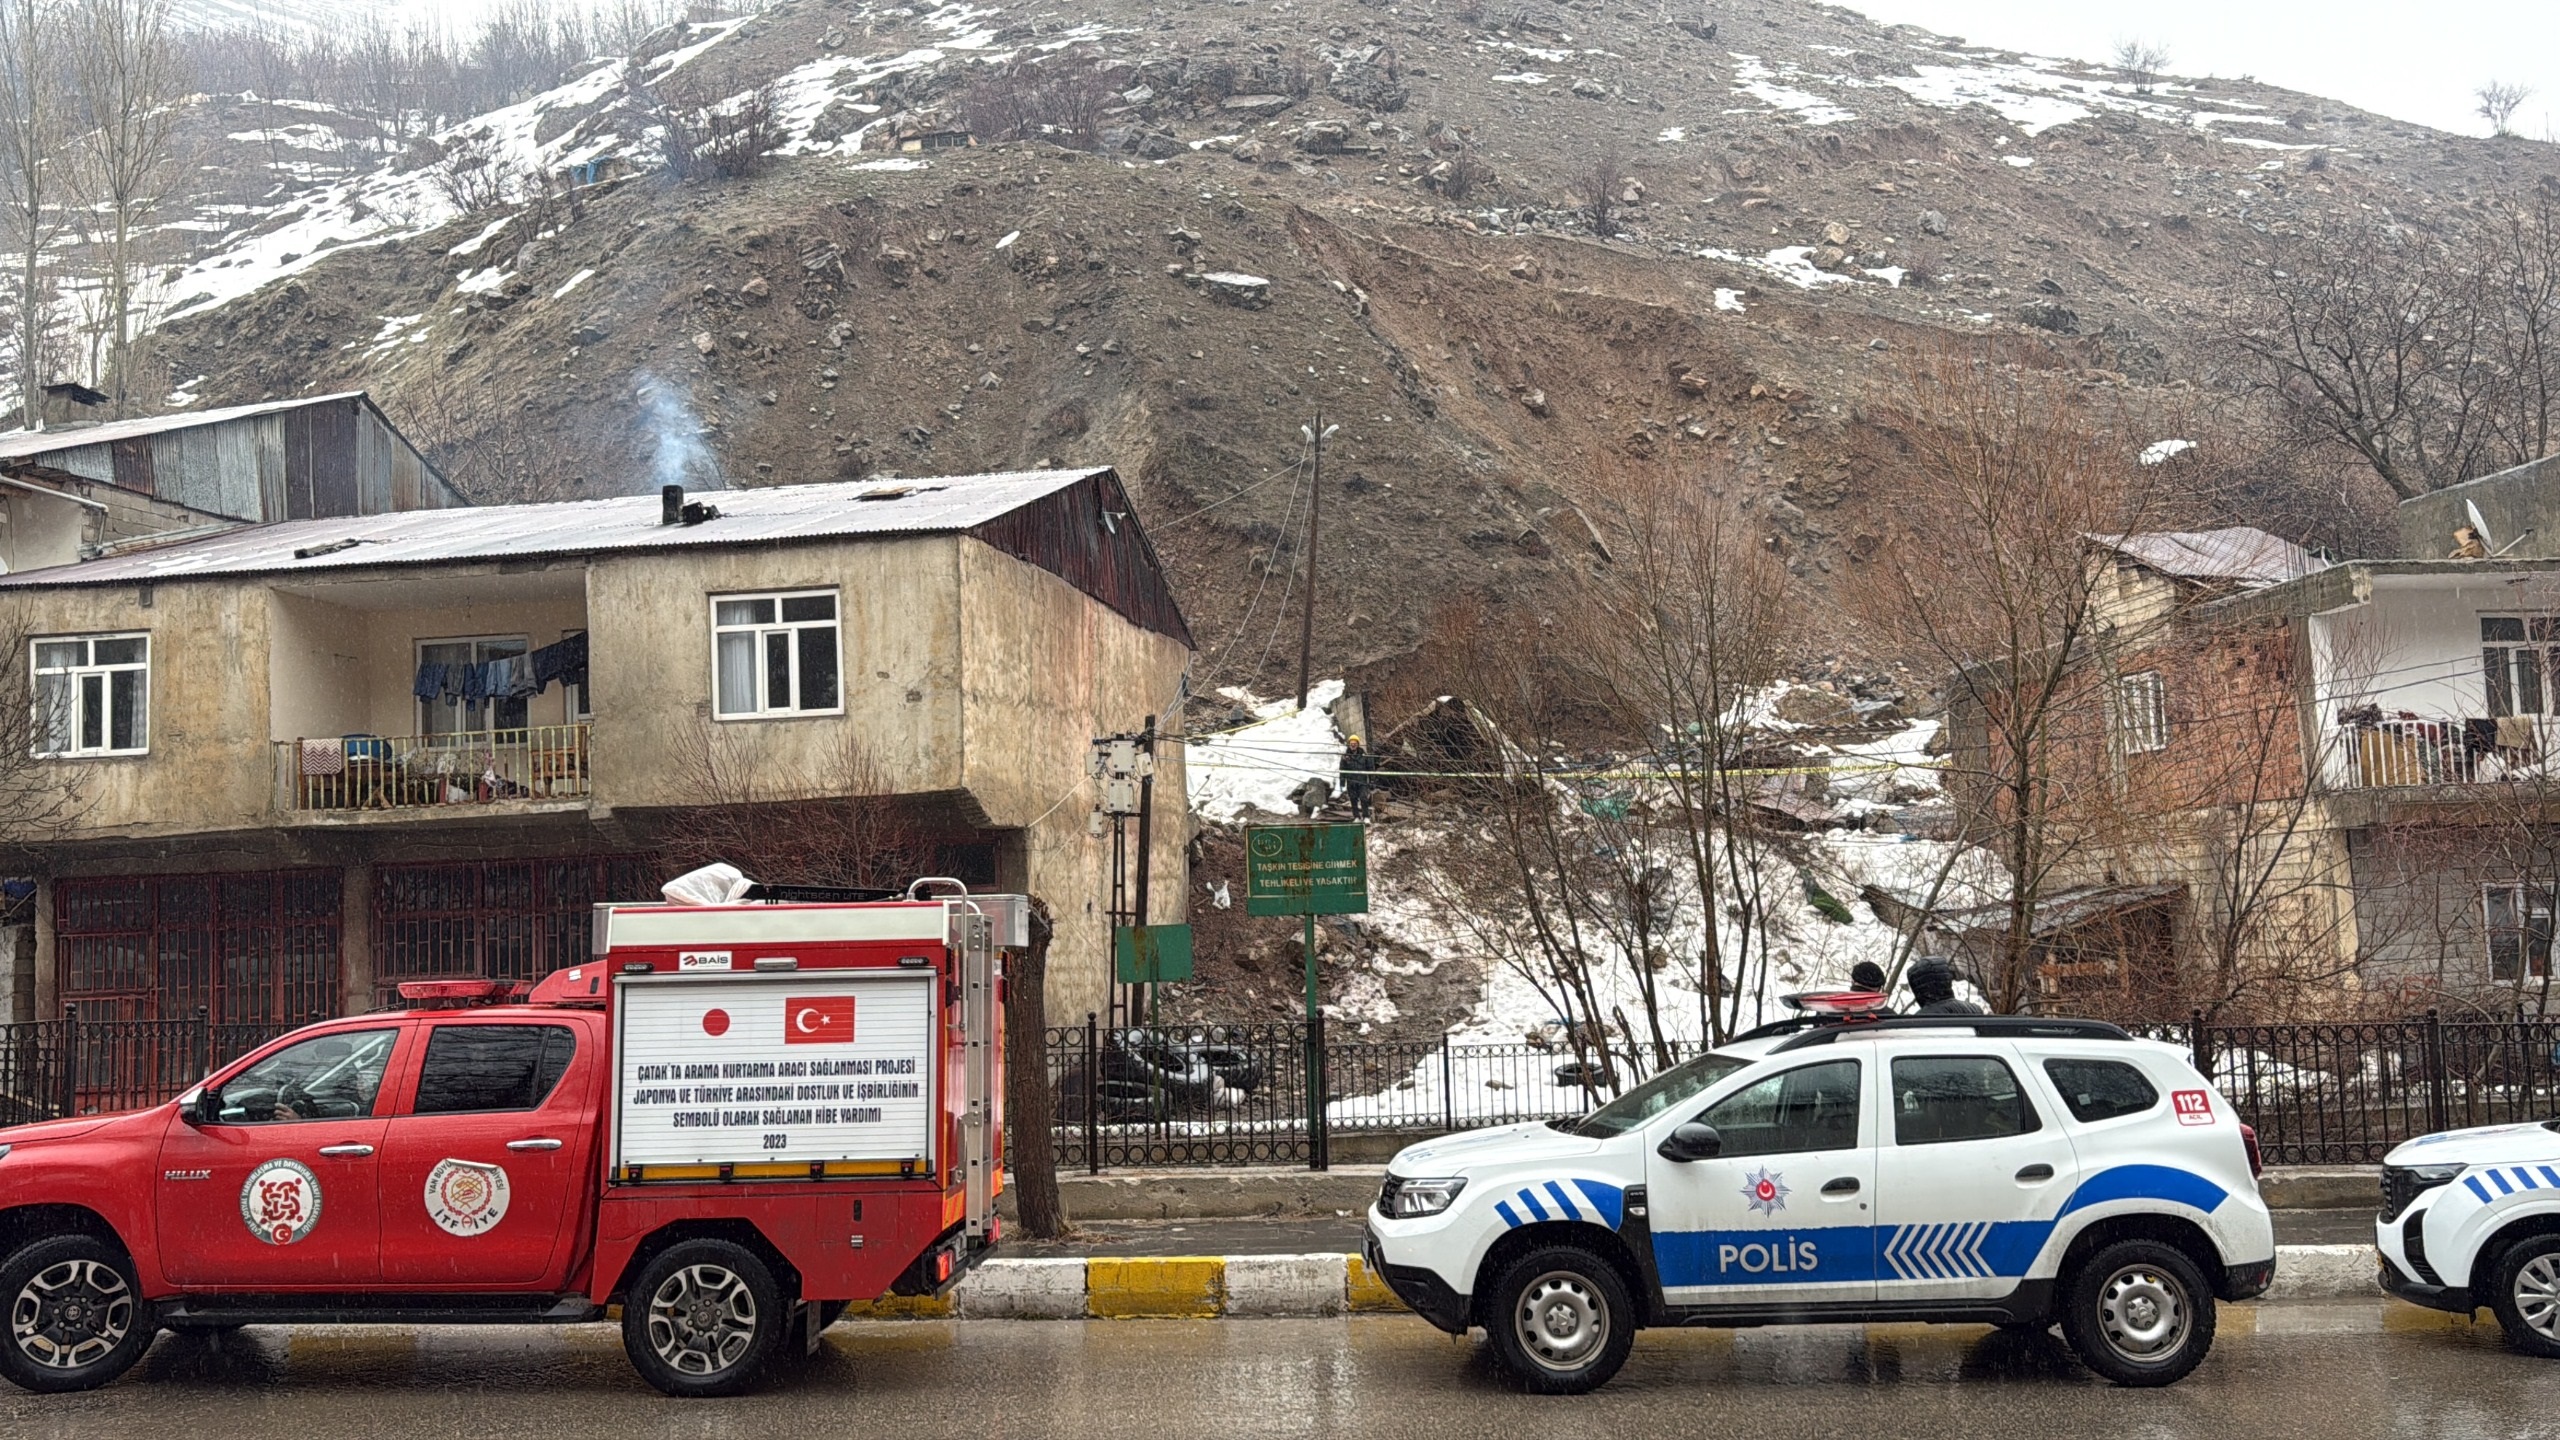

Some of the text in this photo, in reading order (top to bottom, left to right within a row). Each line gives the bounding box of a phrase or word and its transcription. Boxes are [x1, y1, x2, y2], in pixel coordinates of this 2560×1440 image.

[1256, 863, 1286, 872] TAŞKIN
[1260, 877, 1302, 887] TEHLİKELİ
[1303, 878, 1314, 886] VE
[684, 1064, 719, 1080] ARAMA
[722, 1063, 775, 1079] KURTARMA
[778, 1061, 807, 1077] ARACI
[810, 1058, 872, 1076] SAĞLANMASI
[875, 1056, 916, 1075] PROJESİ
[633, 1080, 918, 1104] JAPONYA VE TÜRKİYE ARASINDAKİ DOSTLUK VE İŞBİRLİĞİNİN
[2177, 1094, 2206, 1111] 112
[673, 1105, 881, 1127] SEMBOLÜ OLARAK SAĞLANAN HİBE YARDIMI
[763, 1134, 787, 1149] 2023
[164, 1169, 211, 1180] HILUX
[429, 1178, 438, 1194] VAN
[1719, 1236, 1818, 1273] POLİS
